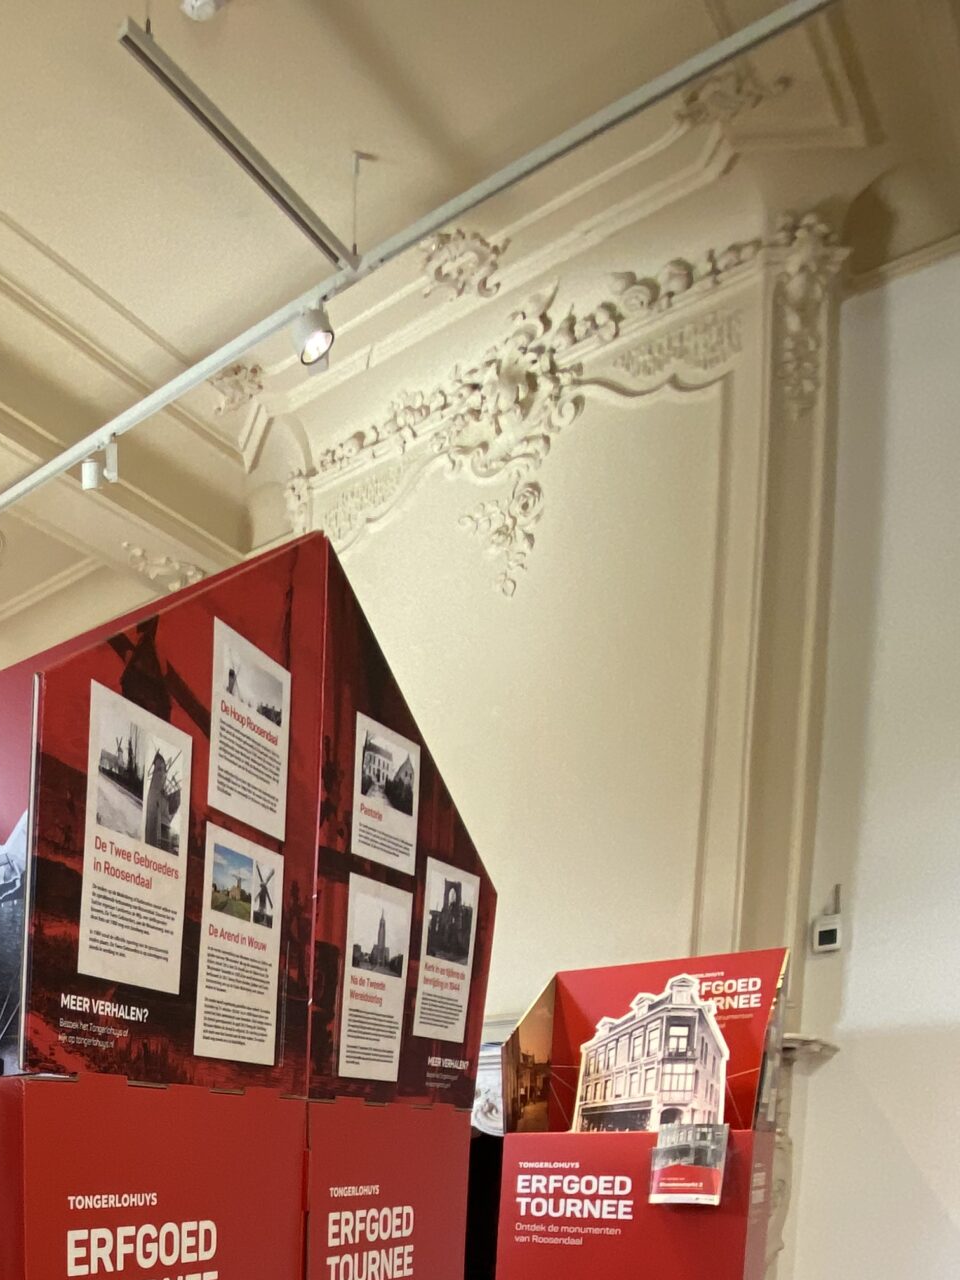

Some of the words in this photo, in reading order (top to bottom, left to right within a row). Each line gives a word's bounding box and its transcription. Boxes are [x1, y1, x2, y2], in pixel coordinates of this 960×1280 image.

[95, 835, 107, 853] De
[109, 841, 132, 862] Twee
[133, 851, 179, 880] Gebroeders
[93, 857, 102, 872] in
[103, 860, 153, 890] Roosendaal
[208, 923, 219, 938] De
[219, 928, 240, 944] Arend
[240, 934, 247, 945] in
[247, 935, 268, 952] Wouw
[701, 977, 762, 995] FGOED
[60, 992, 90, 1013] MEER
[91, 999, 149, 1023] VERHALEN?
[518, 1161, 580, 1169] TONGERLOHUYS
[329, 1184, 380, 1198] TONGERLOHUYS
[517, 1174, 632, 1195] ERFGOED
[68, 1192, 158, 1210] TONGERLOHUYS
[516, 1197, 634, 1220] TOURNEE
[327, 1205, 414, 1248] ERFGOED
[515, 1222, 546, 1232] Ontdek
[548, 1224, 559, 1233] de
[561, 1226, 621, 1235] monumenten
[67, 1219, 218, 1277] ERFGOED
[532, 1234, 583, 1245] Roosendaal
